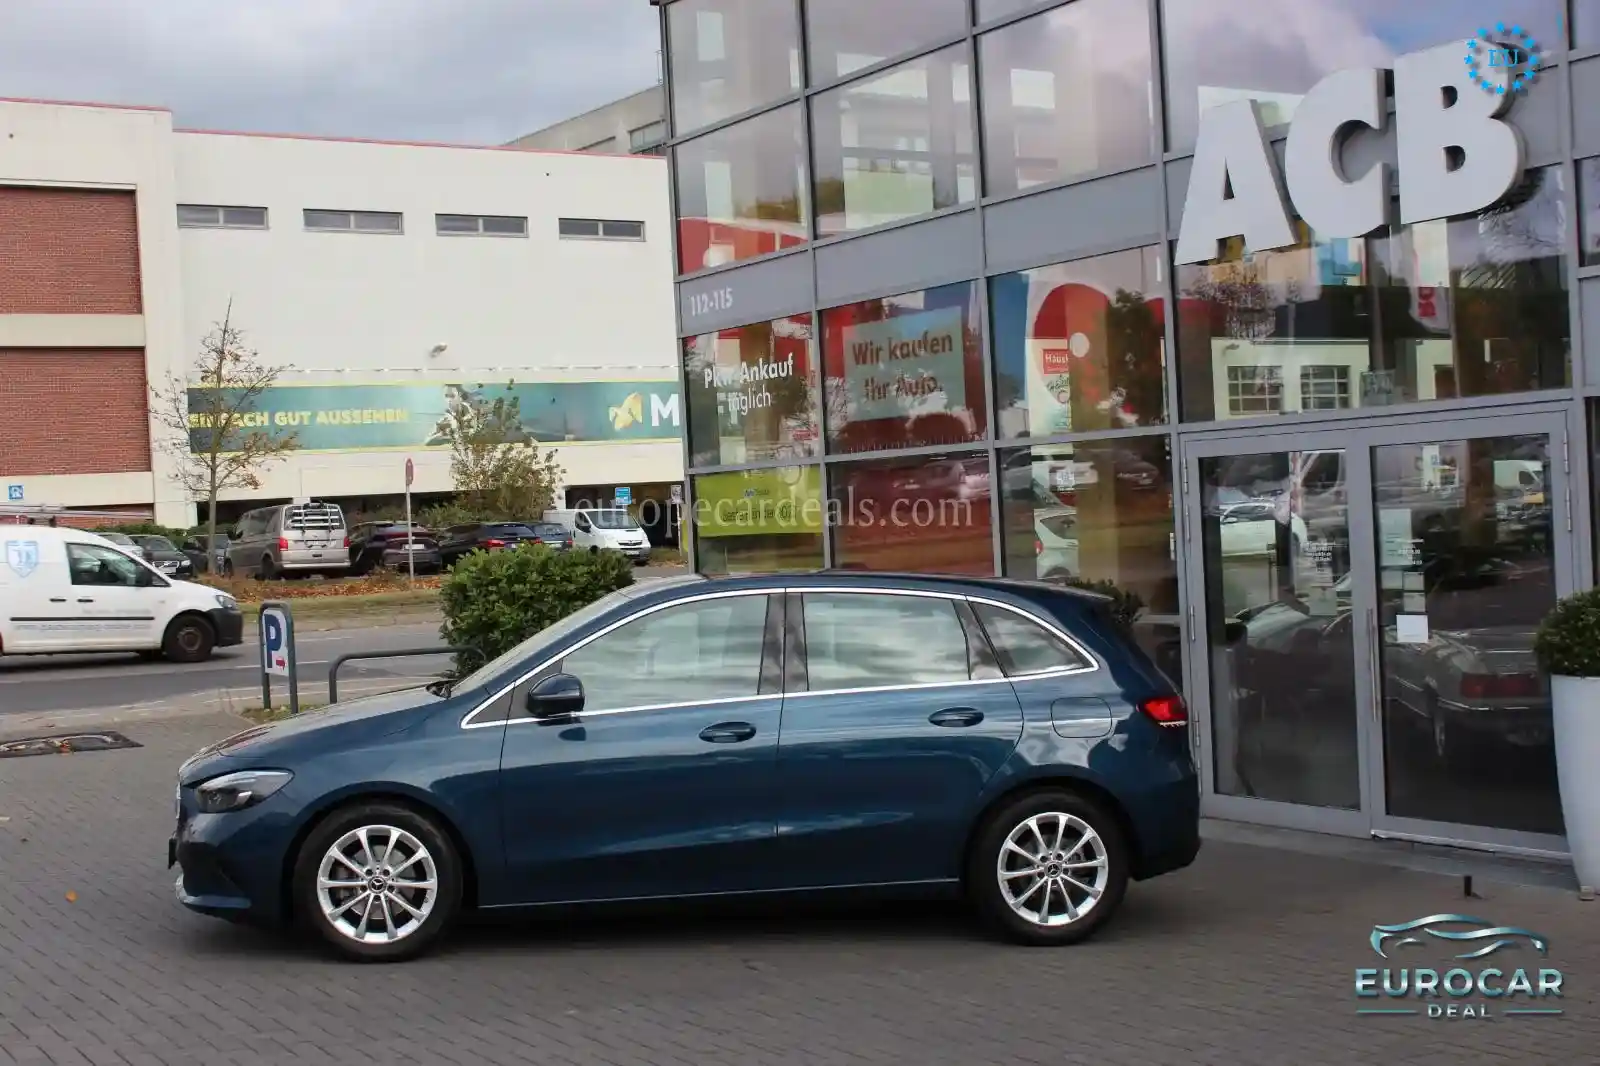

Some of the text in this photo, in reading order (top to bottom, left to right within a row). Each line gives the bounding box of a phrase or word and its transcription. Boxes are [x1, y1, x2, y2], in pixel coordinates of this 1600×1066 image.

[1174, 39, 1526, 266] ACB
[689, 288, 734, 317] 112-115
[852, 330, 953, 366] Wir kaufen
[740, 352, 793, 384] Ankauf
[864, 376, 890, 401] Ihr
[274, 410, 311, 427] GUT
[316, 407, 409, 426] AUSSEHEN
[264, 613, 282, 669] P
